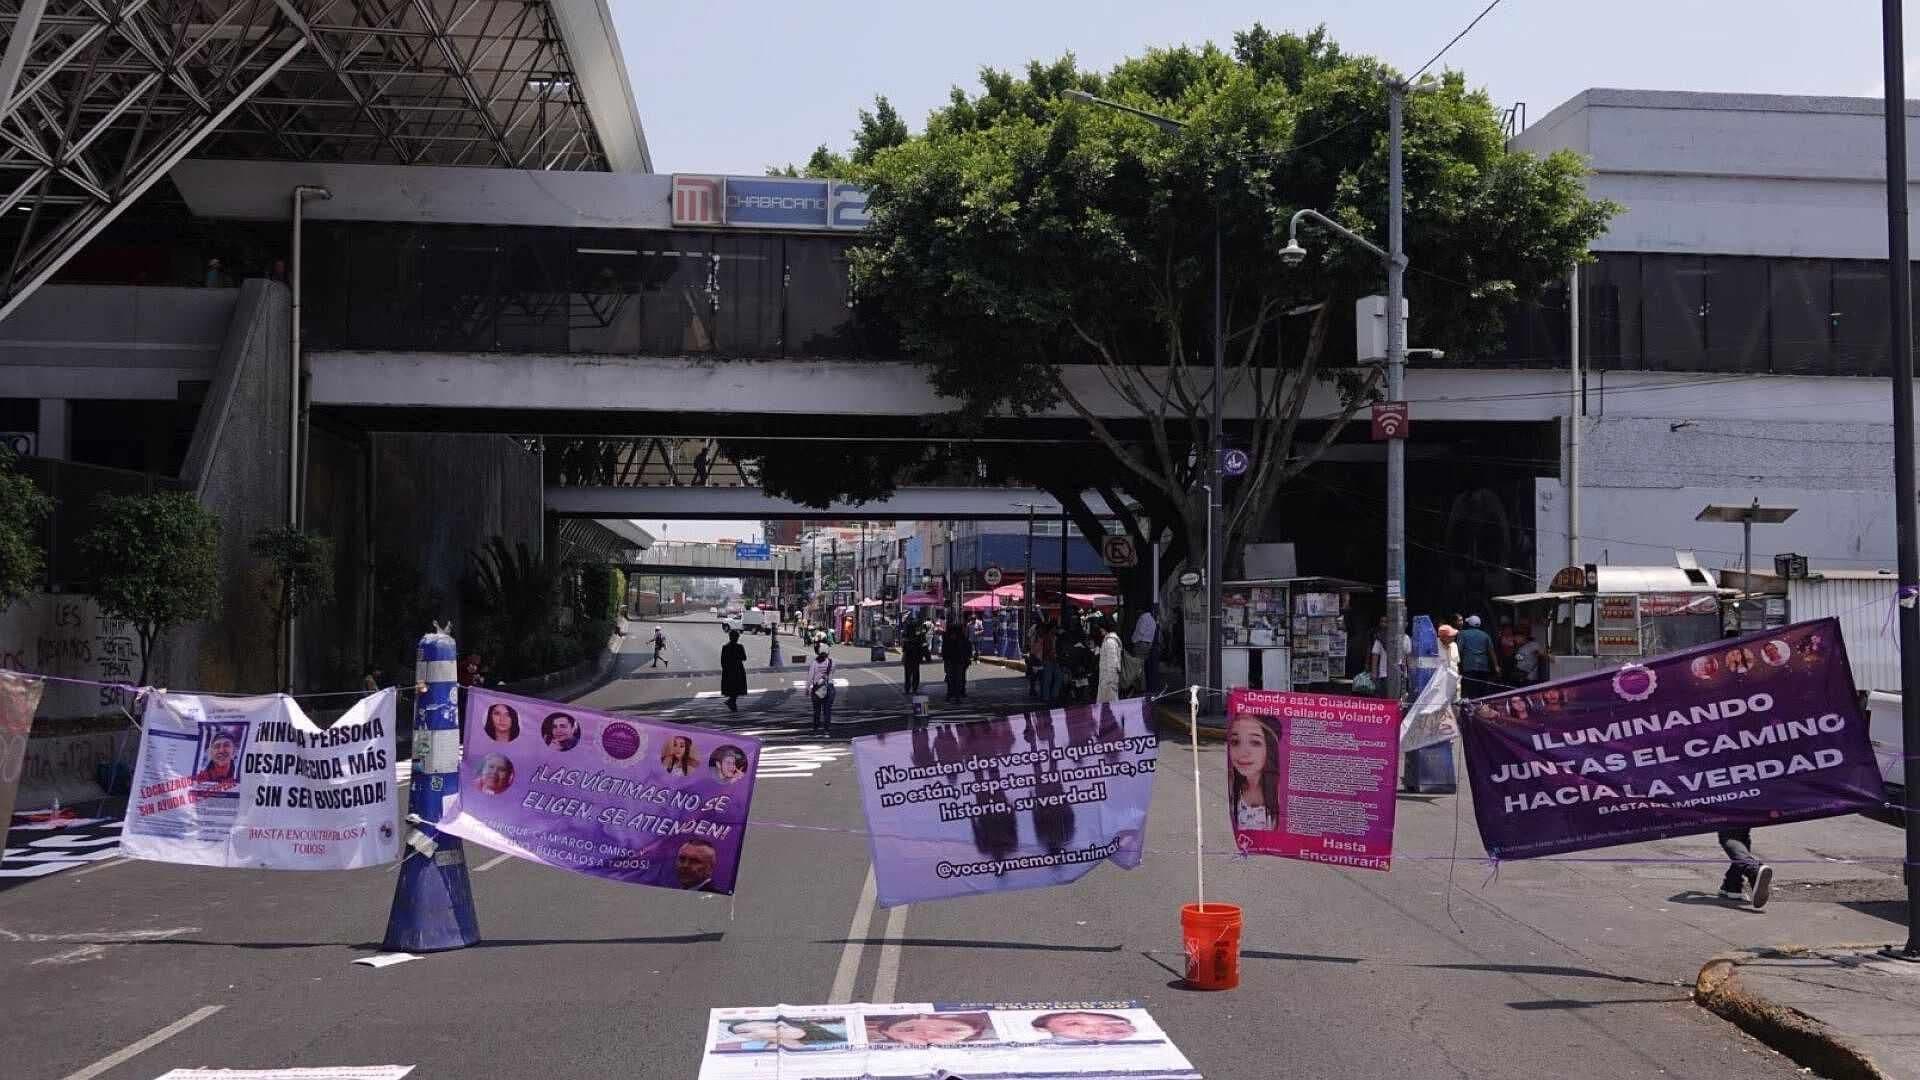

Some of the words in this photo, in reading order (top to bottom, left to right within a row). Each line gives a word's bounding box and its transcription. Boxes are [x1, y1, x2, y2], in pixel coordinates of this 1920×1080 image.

[1236, 703, 1281, 716] Pamela
[1284, 707, 1335, 720] Gallardo
[1338, 711, 1391, 725] Volante?
[1318, 697, 1385, 712] Guadalupe
[310, 717, 385, 748] PERSONA
[1530, 691, 1774, 752] ILUMINANDO
[348, 746, 387, 775] MÁS
[875, 766, 907, 789] ¡No
[909, 760, 966, 779] maten
[968, 754, 998, 772] dos
[999, 749, 1048, 768] veces
[1052, 745, 1063, 760] a
[1065, 737, 1133, 763] quienes
[1134, 732, 1157, 753] ya
[1490, 751, 1627, 784] JUNTAS
[1631, 746, 1680, 769] EL
[1684, 711, 1846, 760] CAMINO
[255, 785, 283, 808] SIN
[287, 786, 313, 809] SER
[314, 780, 387, 809] BUSCADA!
[531, 764, 578, 786] ¡LAS
[579, 768, 670, 805] VÍCTIMAS
[670, 790, 701, 811] NO
[701, 793, 730, 813] SE
[881, 793, 906, 808] no
[907, 781, 960, 803] están,
[962, 773, 1037, 801] respeten
[1039, 770, 1060, 785] su
[1062, 758, 1136, 783] nombre,
[1138, 758, 1157, 773] su
[1504, 784, 1620, 814] HACIA
[1623, 777, 1677, 800] LA
[1678, 747, 1844, 793] VERDAD
[939, 797, 1013, 823] historia,
[1015, 795, 1036, 812] su
[1037, 783, 1106, 808] verdad!
[1598, 801, 1649, 815] BASTA
[1671, 788, 1761, 809] IMPUNIDAD
[598, 807, 626, 826] SE
[627, 812, 731, 841] ATIENDEN!
[1299, 848, 1389, 869] Encontrarla
[1323, 837, 1367, 853] Hasta
